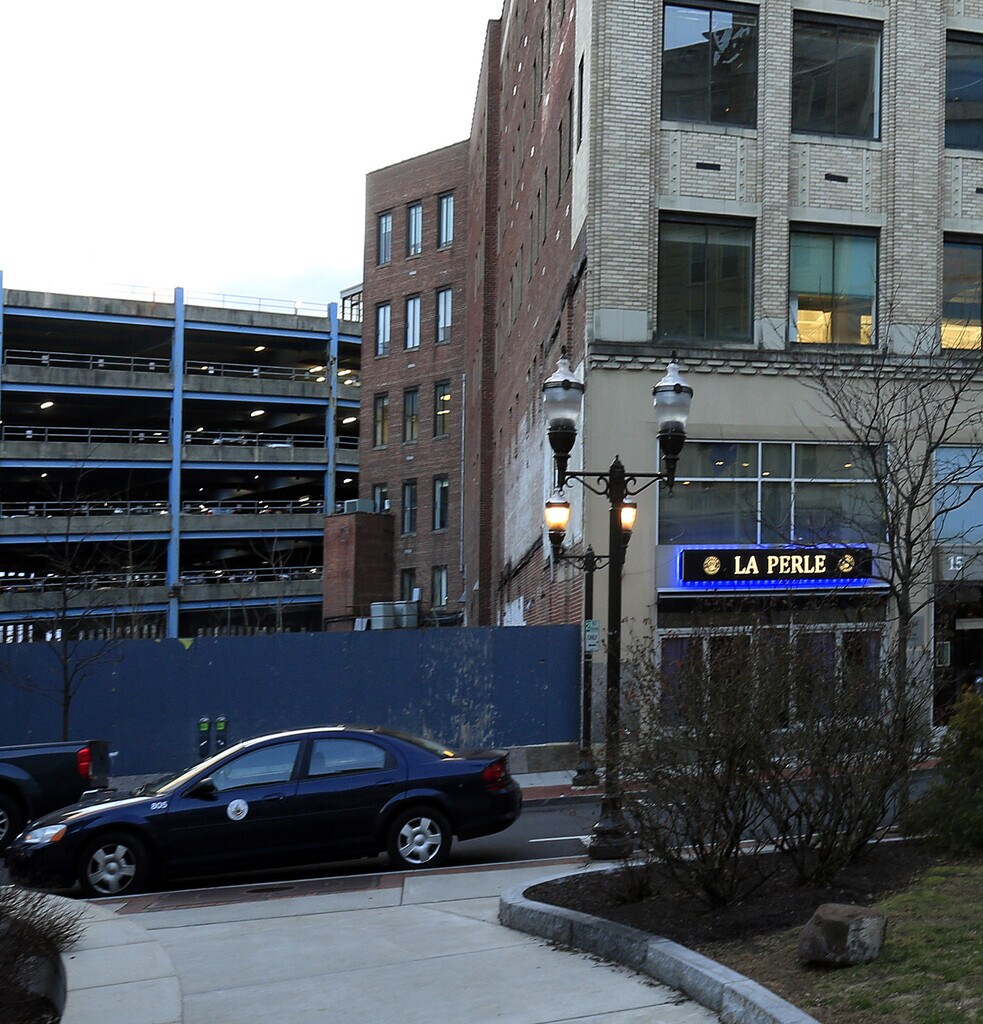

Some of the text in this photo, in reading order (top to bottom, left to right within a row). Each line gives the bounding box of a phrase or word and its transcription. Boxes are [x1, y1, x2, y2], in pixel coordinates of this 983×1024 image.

[734, 555, 827, 575] LA PERLE
[947, 555, 965, 571] 15
[150, 800, 168, 810] 805
